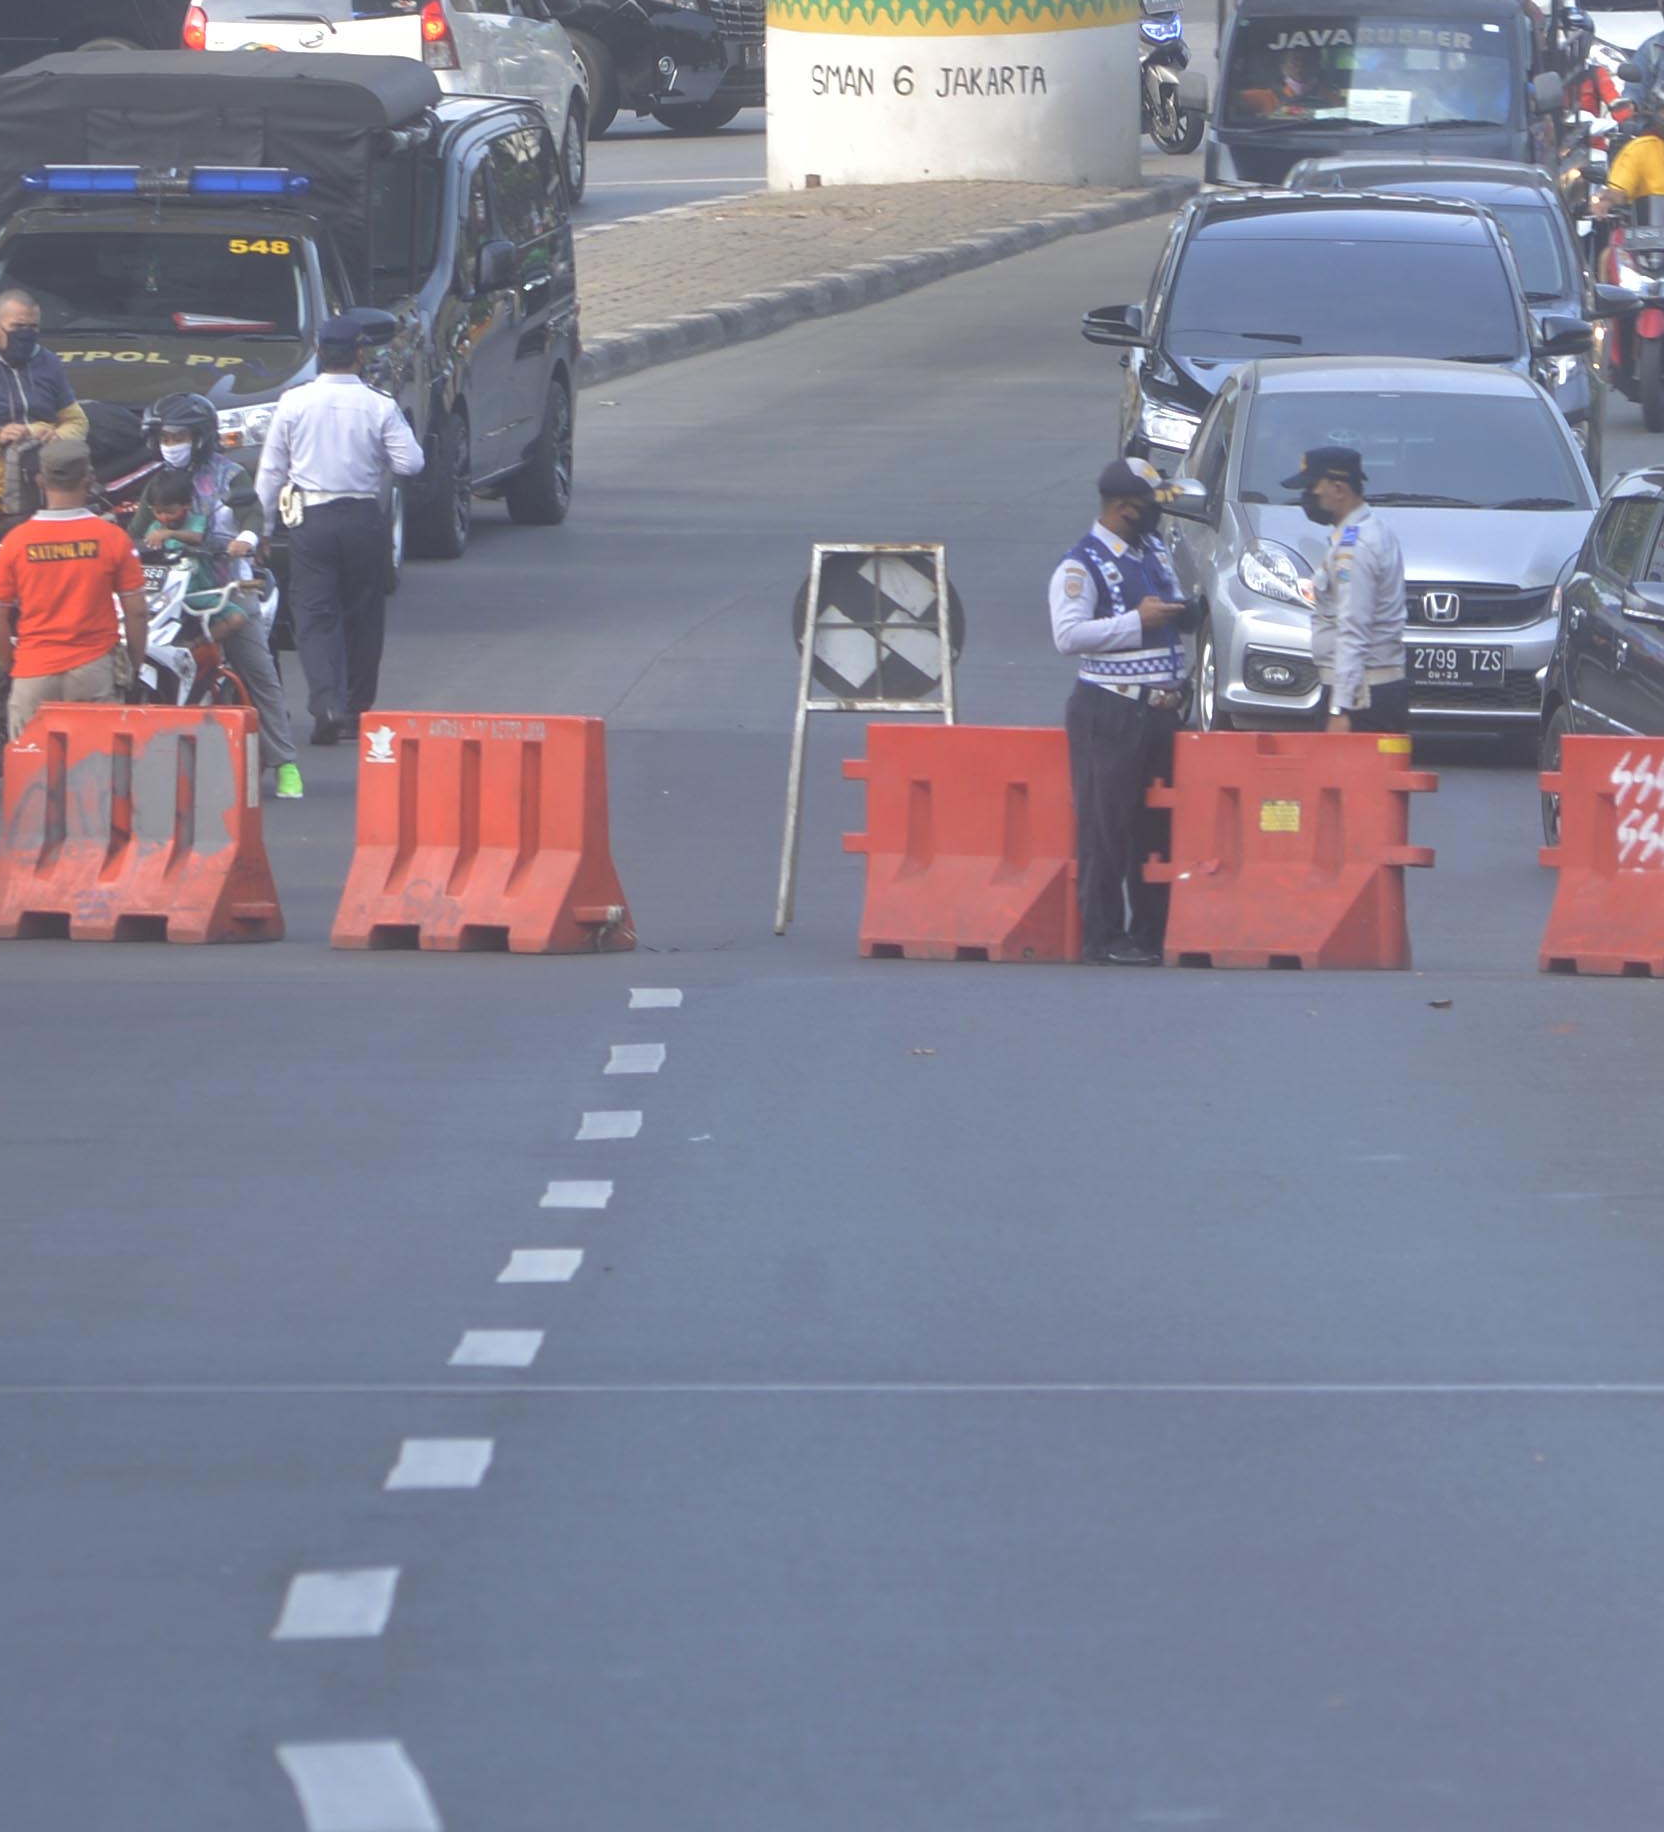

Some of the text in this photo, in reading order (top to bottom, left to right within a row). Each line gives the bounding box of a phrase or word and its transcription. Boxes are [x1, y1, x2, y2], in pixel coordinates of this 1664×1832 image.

[1268, 27, 1473, 50] JAVA RUBBER
[811, 65, 1048, 98] SMAN 6 JAKARTA
[228, 239, 290, 255] 548
[186, 354, 244, 369] PP
[79, 541, 97, 558] PP
[1414, 648, 1502, 671] 2799 TZS
